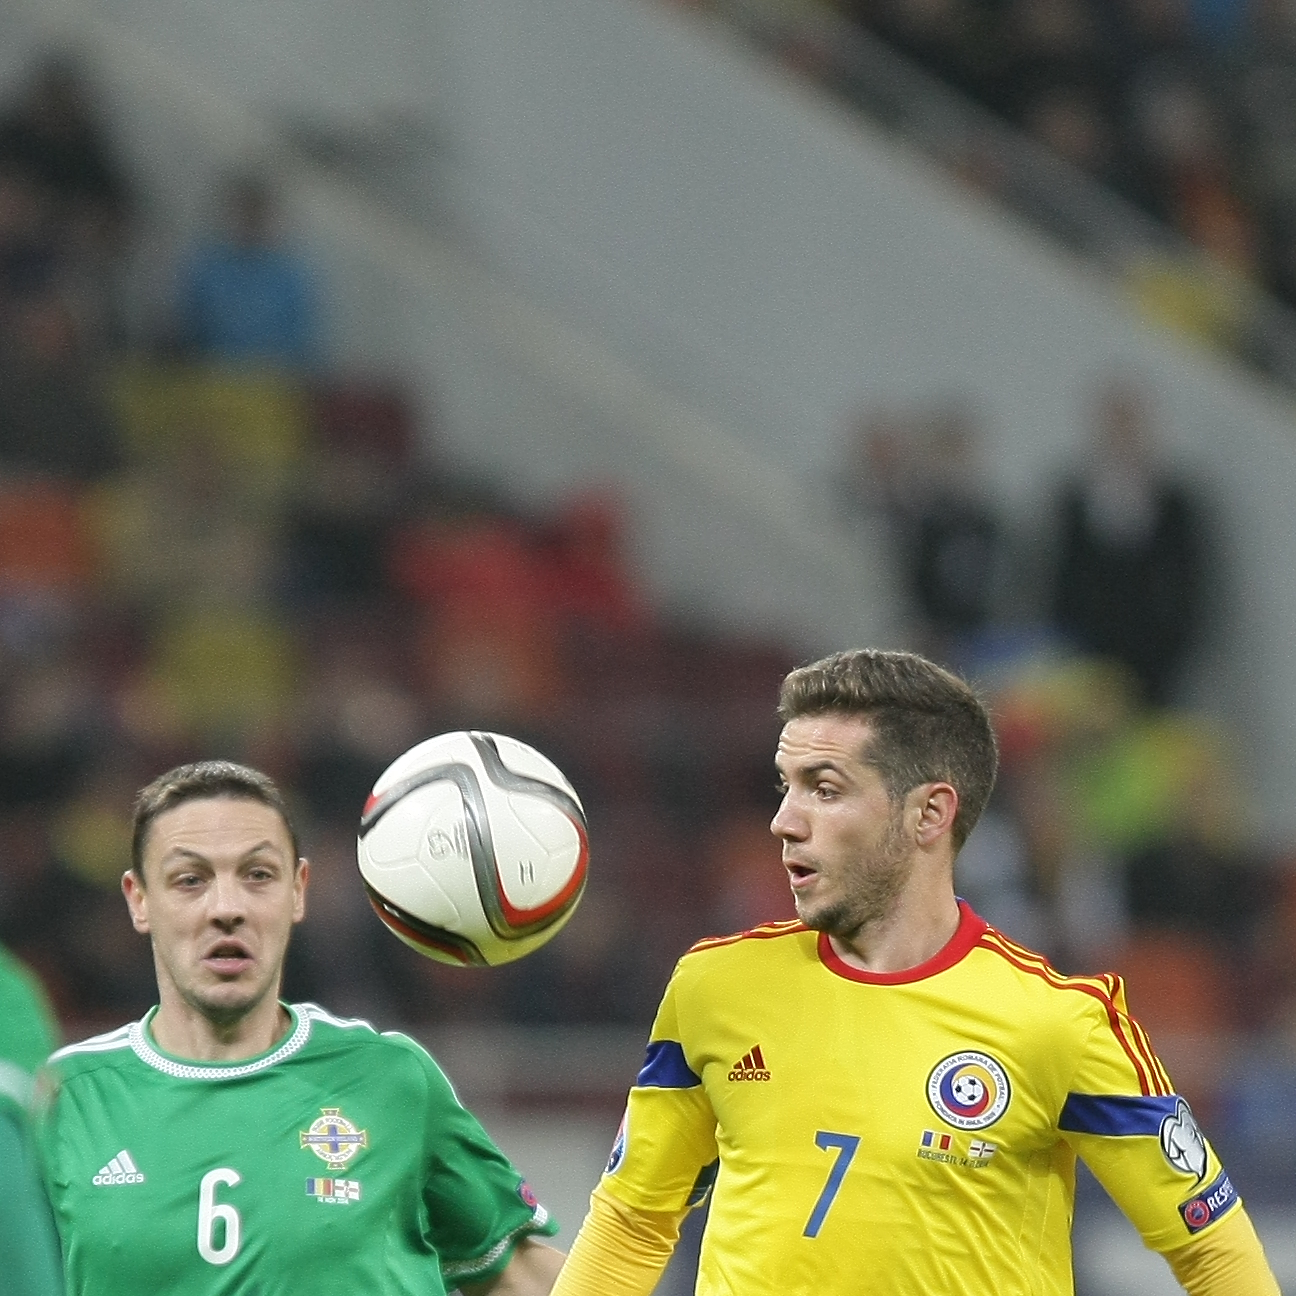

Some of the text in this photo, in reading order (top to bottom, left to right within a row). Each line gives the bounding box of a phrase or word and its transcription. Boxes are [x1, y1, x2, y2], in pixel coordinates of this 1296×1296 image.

[728, 1068, 771, 1082] adidas
[92, 1172, 144, 1185] adidas
[803, 1130, 861, 1238] 7
[196, 1168, 243, 1265] 6
